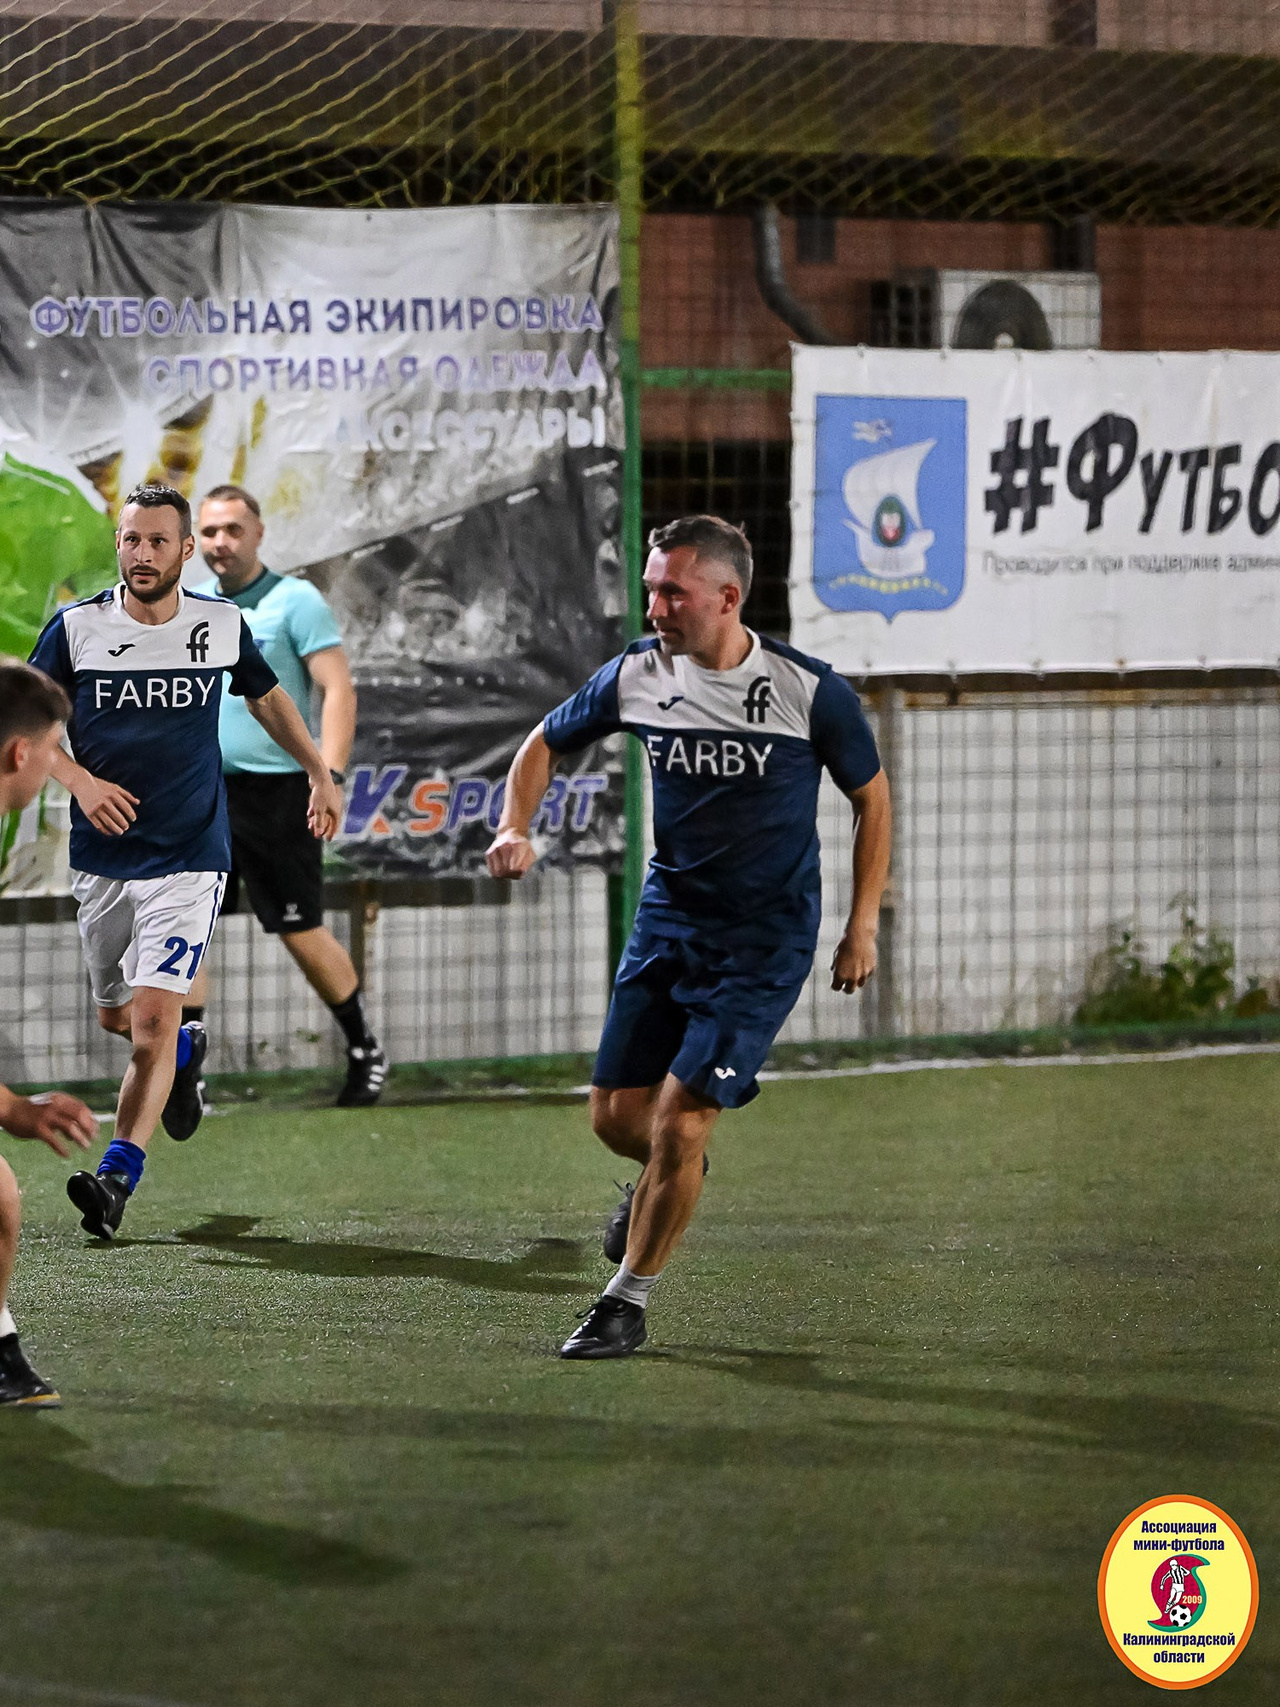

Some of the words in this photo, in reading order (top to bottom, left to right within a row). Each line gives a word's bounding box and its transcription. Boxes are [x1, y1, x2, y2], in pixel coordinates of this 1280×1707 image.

[30, 296, 311, 338] ФУТБОЛЬНАЯ
[325, 295, 604, 334] ЭКИПИРОВКА
[147, 354, 418, 394] СПОРТИВНАЯ
[95, 676, 216, 709] FARBY
[646, 734, 773, 777] FARBY
[157, 936, 204, 980] 21
